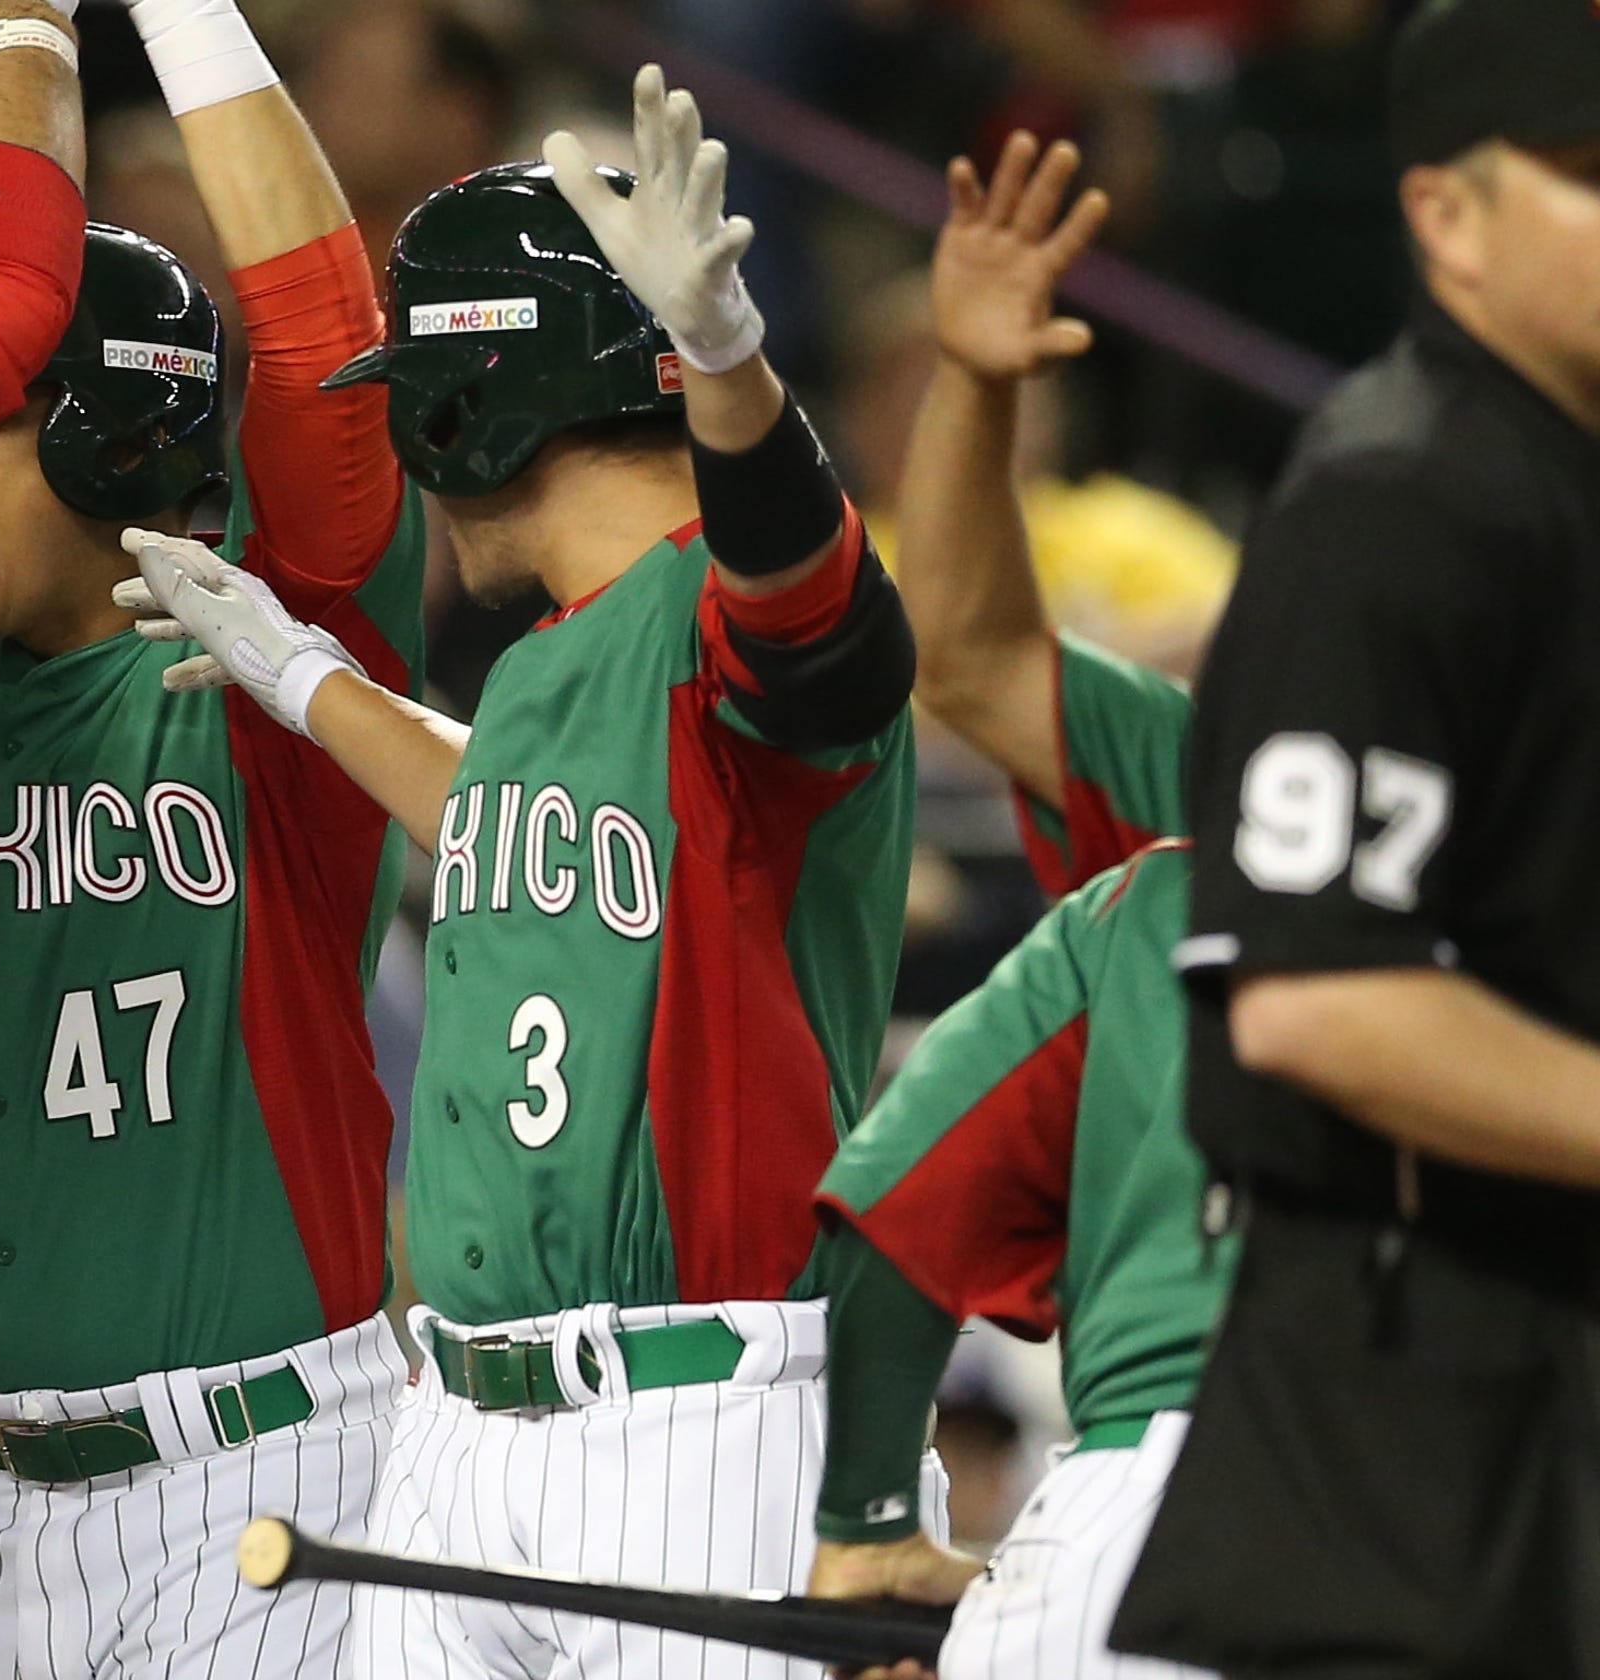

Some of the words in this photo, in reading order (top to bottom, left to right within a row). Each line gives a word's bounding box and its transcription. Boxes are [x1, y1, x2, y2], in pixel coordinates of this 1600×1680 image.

[431, 781, 663, 940] XICO
[1233, 730, 1455, 913] 97
[43, 968, 187, 1139] 47
[506, 993, 570, 1149] 3
